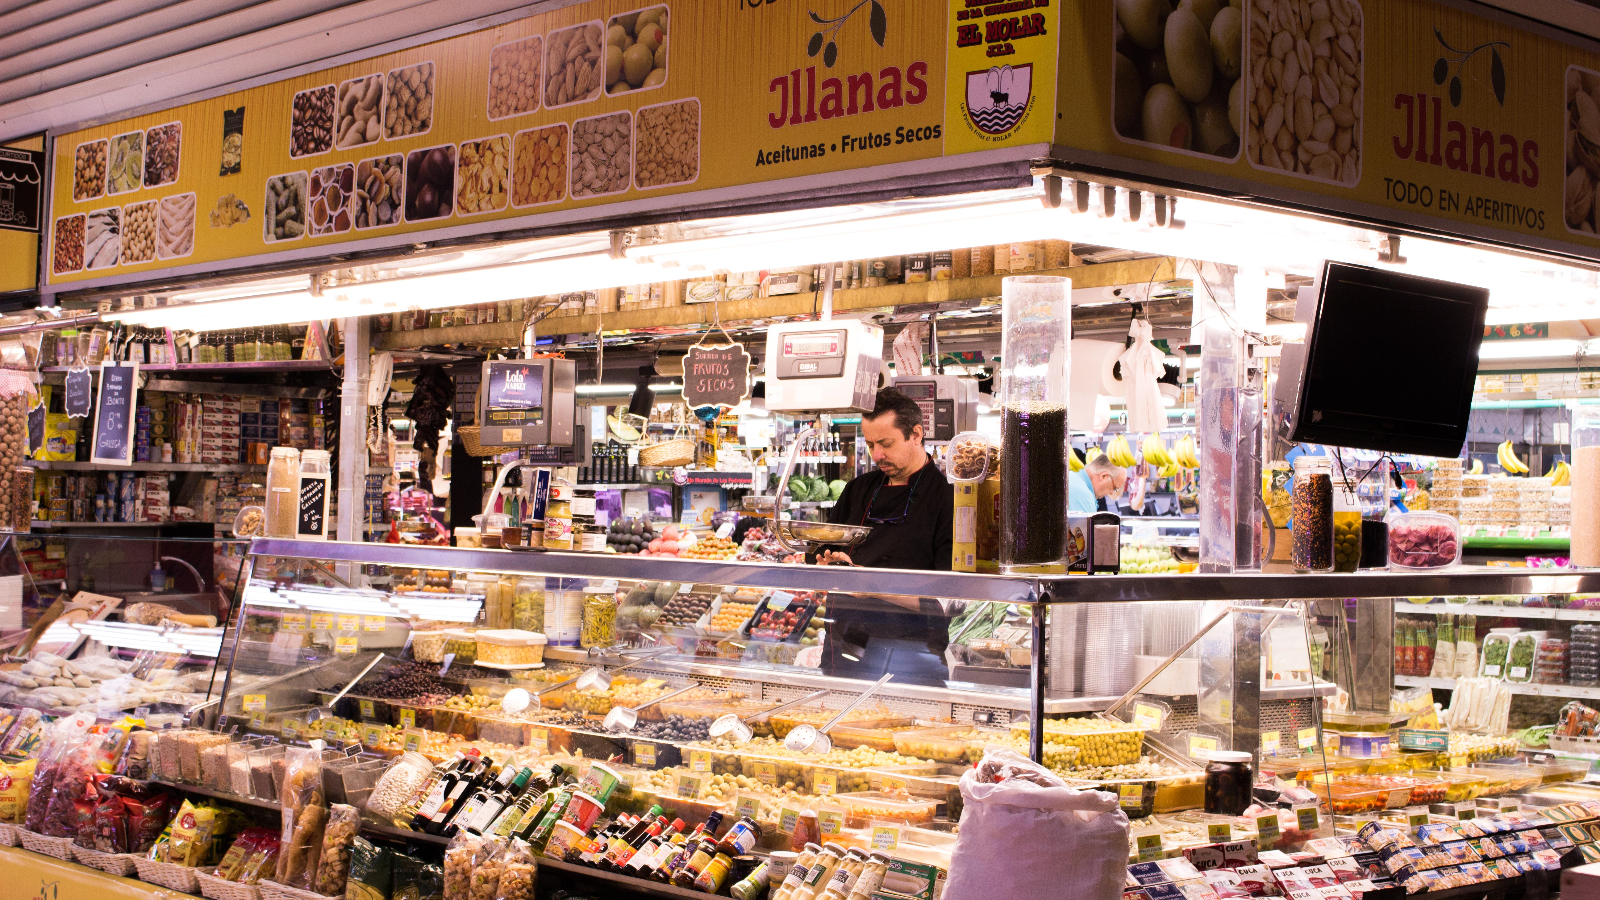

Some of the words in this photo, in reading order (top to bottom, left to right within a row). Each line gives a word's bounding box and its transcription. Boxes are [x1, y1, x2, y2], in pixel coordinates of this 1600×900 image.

[957, 10, 969, 21] DE
[970, 8, 983, 19] LA
[957, 23, 982, 48] EL
[985, 13, 1047, 42] MOLAR
[755, 143, 825, 167] Aceitunas
[841, 132, 891, 153] Frutos
[895, 124, 942, 145] Secos
[1384, 177, 1433, 208] TODO
[1438, 189, 1460, 213] EN
[1464, 196, 1545, 231] APERITIVOS
[506, 370, 524, 382] Lola
[693, 364, 730, 376] FRUTOS
[502, 382, 526, 392] MARKET
[696, 378, 735, 393] SECOS
[1226, 844, 1244, 852] CUCA
[1196, 859, 1217, 869] CUCA
[1238, 868, 1258, 876] CUCA
[1304, 867, 1323, 875] CUCA
[1292, 891, 1311, 899] CUCA
